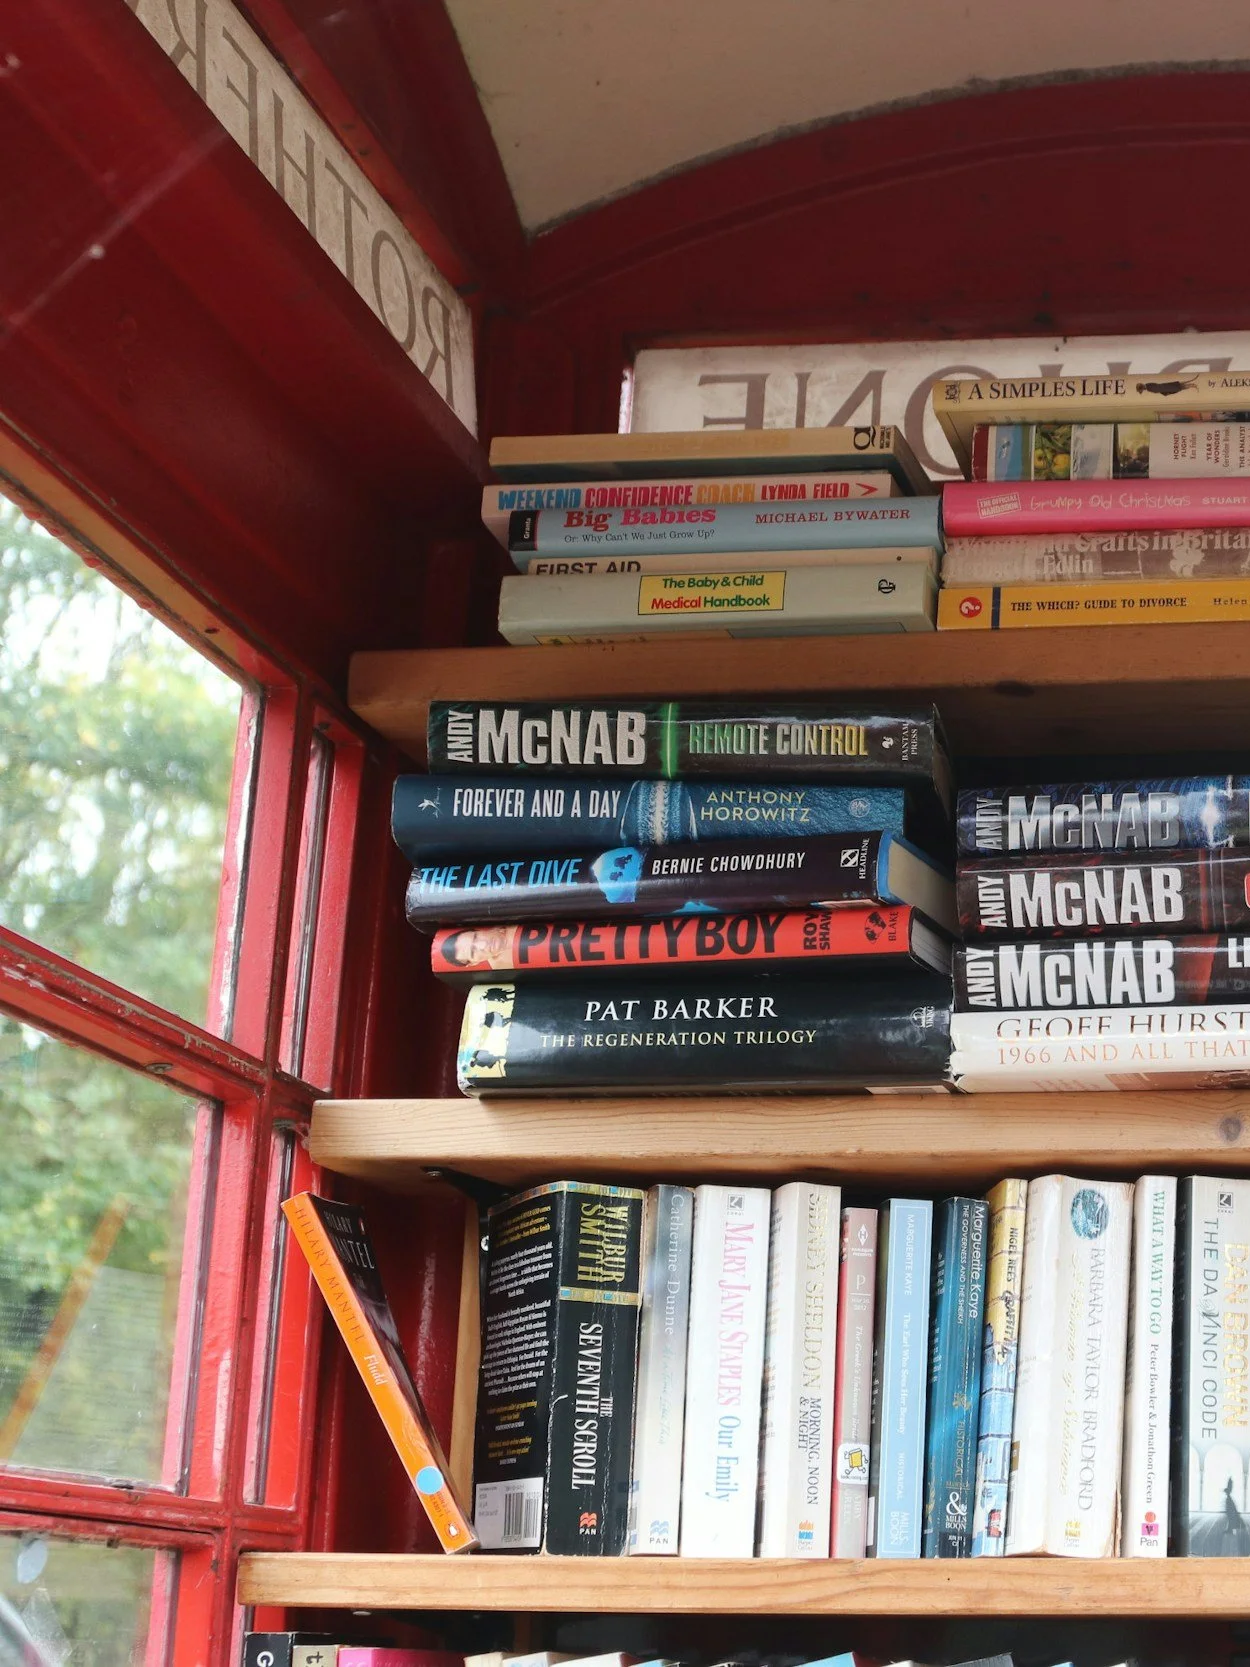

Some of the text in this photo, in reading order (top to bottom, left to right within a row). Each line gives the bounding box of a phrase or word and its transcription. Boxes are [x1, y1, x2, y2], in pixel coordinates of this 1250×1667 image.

[989, 380, 1076, 399] SIMPLES
[1080, 378, 1127, 396] LIFE
[1213, 429, 1221, 464] WONDERS
[498, 482, 849, 511] WEEKEND CONFIDENCE COACH LYNDA FIELD
[1202, 496, 1247, 505] STUART
[523, 517, 531, 540] Granta
[563, 508, 911, 532] Big Babies MICHAEL BYWATER
[582, 530, 694, 545] Why Grow
[662, 575, 765, 591] The Baby Child
[651, 594, 770, 610] Medical Handbook
[1011, 602, 1032, 611] THE
[1084, 599, 1117, 609] GUIDE
[1139, 597, 1187, 608] DIVORCE
[447, 708, 869, 766] ANDY McNAB REMOTE CONTROL
[453, 788, 621, 819] FOREVER AND DAY
[700, 806, 811, 822] HOROWITZ
[706, 790, 807, 805] ANTHONY
[975, 796, 1003, 851] ANDY
[1008, 791, 1180, 851] McNAB
[418, 852, 806, 895] THE LAST DIVE BERNIE CHOWDHURY
[858, 837, 870, 880] HEADLINE
[517, 913, 788, 965] PRETTY BOY
[888, 911, 899, 942] BLAKE
[584, 997, 778, 1022] PAT BARKER
[540, 1030, 817, 1048] THE REGENERATION TRILOGY
[996, 1014, 1113, 1041] GEOFF
[998, 1046, 1051, 1065] 1966
[1063, 1043, 1118, 1063] AND
[1131, 1041, 1174, 1060] ALL
[577, 1202, 606, 1283] SMITH
[600, 1204, 630, 1283] WILBUR
[667, 1193, 685, 1272] Catherine
[904, 1214, 915, 1270] MARGUERITE
[1008, 1228, 1019, 1256] NIGEL
[969, 1204, 986, 1319] Marguerite Kaye
[664, 1280, 681, 1335] Dunne
[717, 1221, 755, 1406] MARY JANE STAPLES
[1147, 1190, 1165, 1470] WHAT Jonathon
[1201, 1218, 1222, 1440] THE VINCI CODE
[1222, 1243, 1250, 1427] DAN BROWN
[363, 1353, 389, 1387] Fludd
[571, 1322, 604, 1490] SEVENTH SCROLL
[705, 1415, 742, 1503] Our Emily
[1077, 1410, 1099, 1511] BRADFORD
